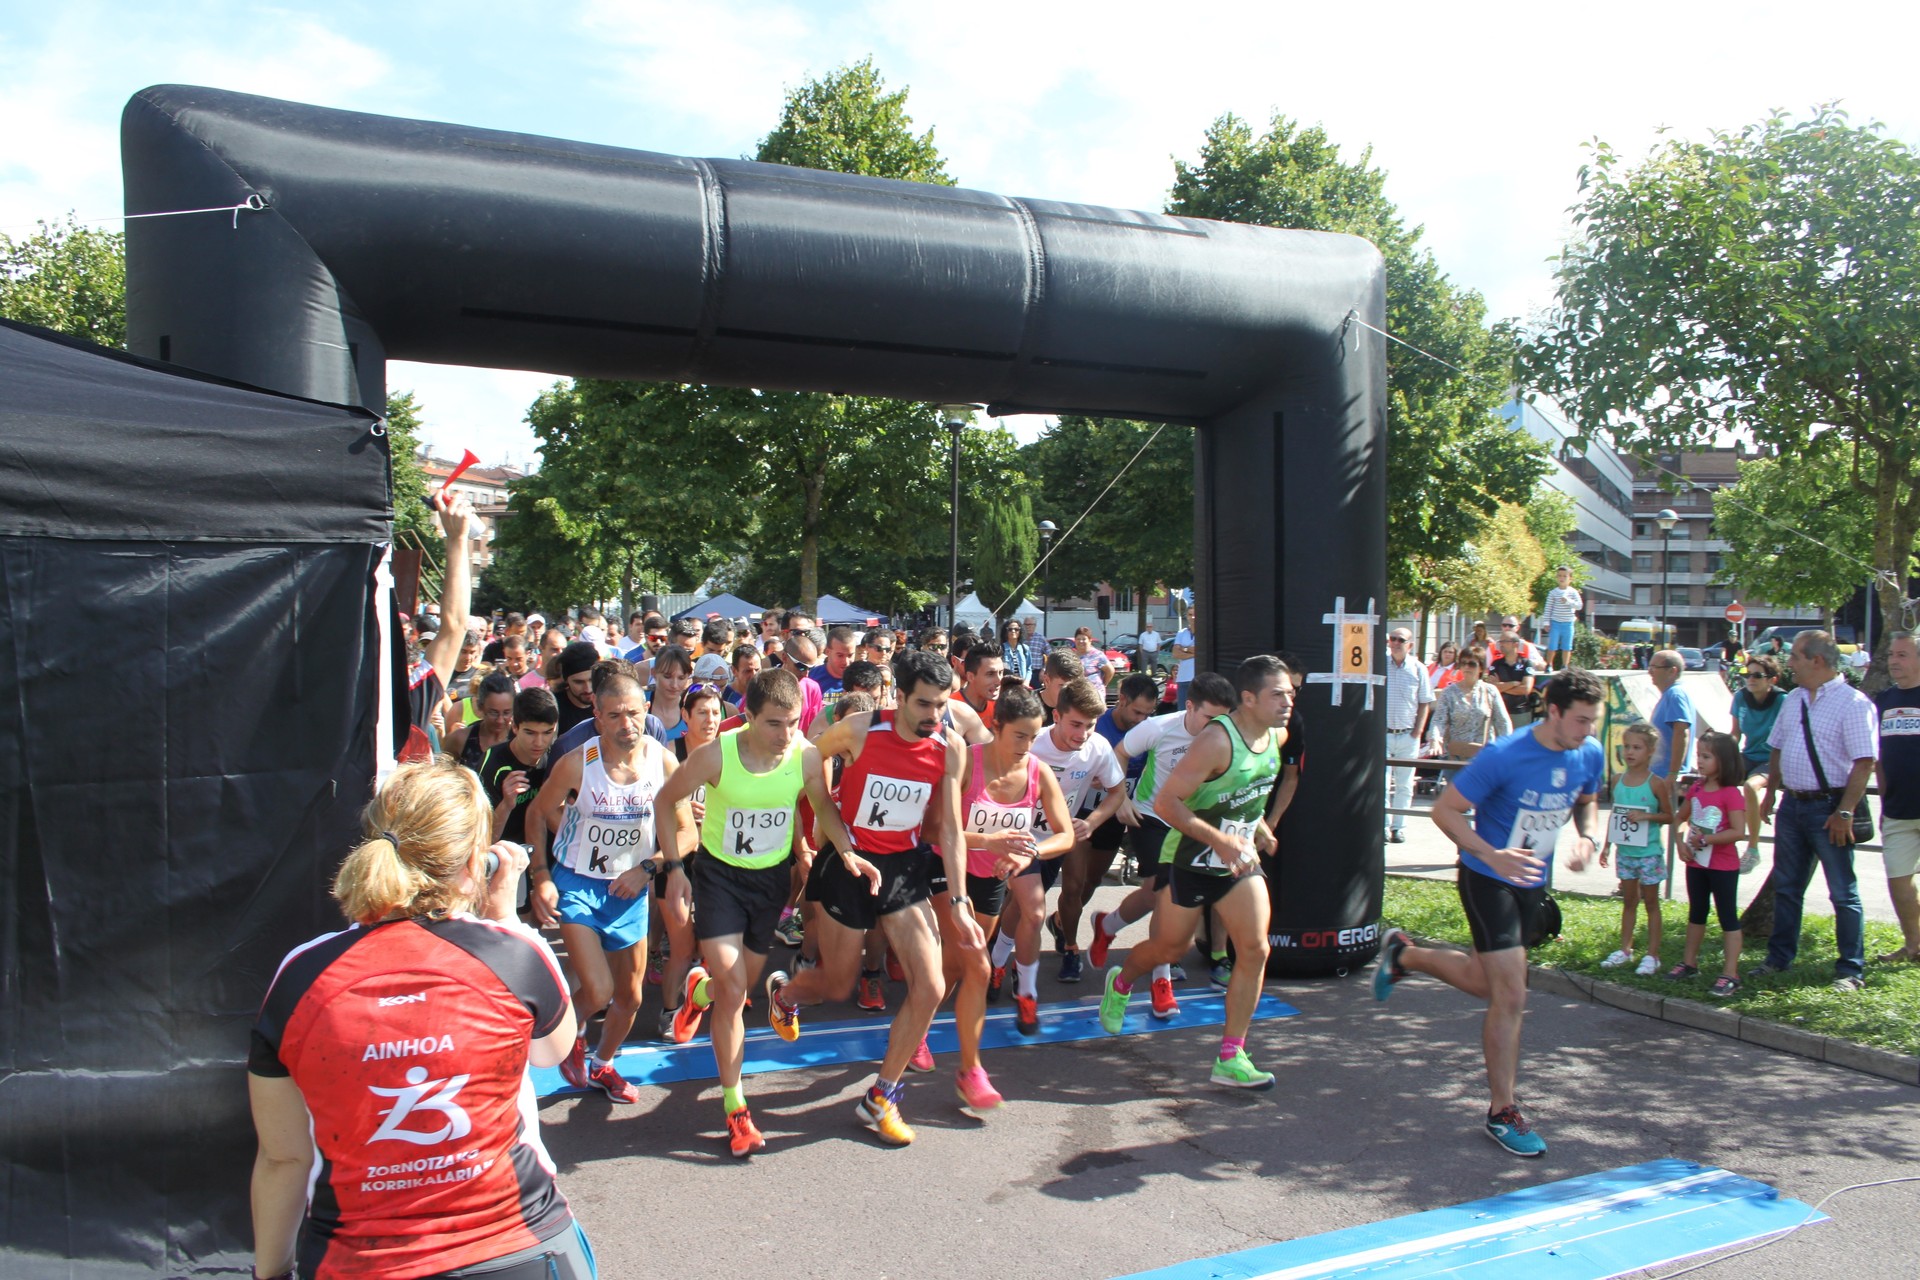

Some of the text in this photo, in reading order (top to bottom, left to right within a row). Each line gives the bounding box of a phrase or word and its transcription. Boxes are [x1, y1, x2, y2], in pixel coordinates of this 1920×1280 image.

[1351, 625, 1363, 634] KM
[1351, 646, 1363, 667] 8
[1882, 718, 1920, 730] SAN DIEGO
[870, 780, 922, 804] 0001
[732, 811, 786, 829] 0130
[974, 809, 1026, 830] 0100
[1614, 815, 1639, 833] 185
[588, 824, 641, 847] 0089
[361, 1034, 455, 1062] AINHOA
[366, 1148, 480, 1179] ZORNOTZAKO
[361, 1159, 495, 1192] KORRIKALARIAK
